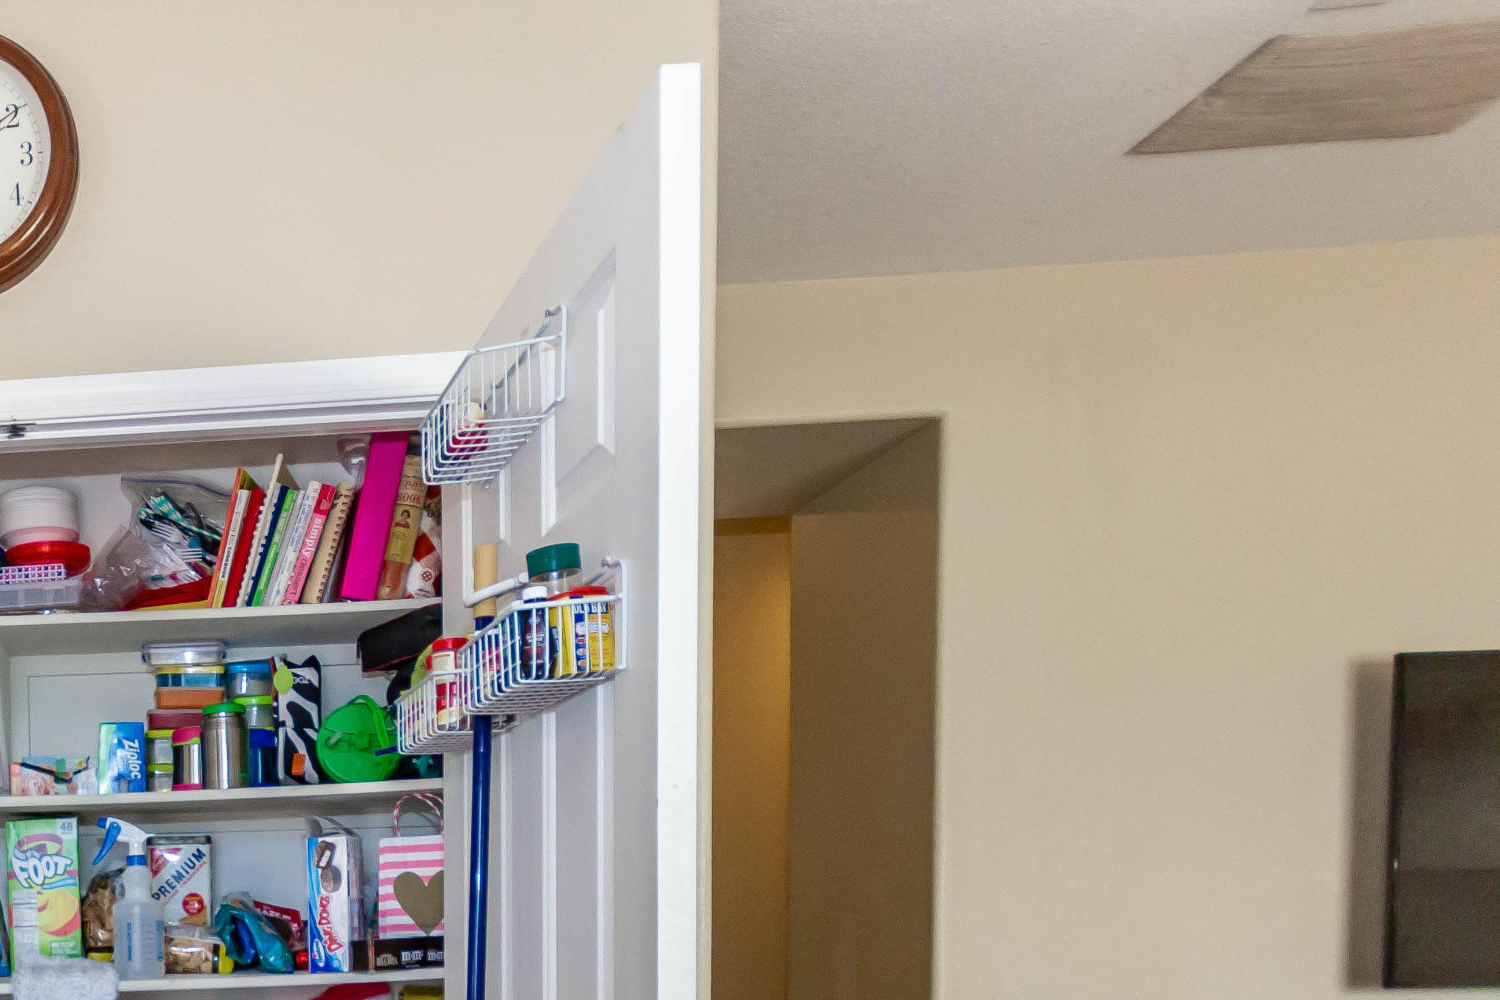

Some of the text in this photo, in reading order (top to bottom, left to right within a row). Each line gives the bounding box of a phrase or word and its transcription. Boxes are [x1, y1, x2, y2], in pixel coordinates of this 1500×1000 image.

[5, 103, 20, 128] 2
[20, 141, 33, 166] 3
[9, 182, 24, 206] 4
[121, 738, 142, 780] Ziploc
[60, 821, 74, 833] 48
[11, 854, 73, 889] FOOT
[150, 847, 207, 901] PREMIUM
